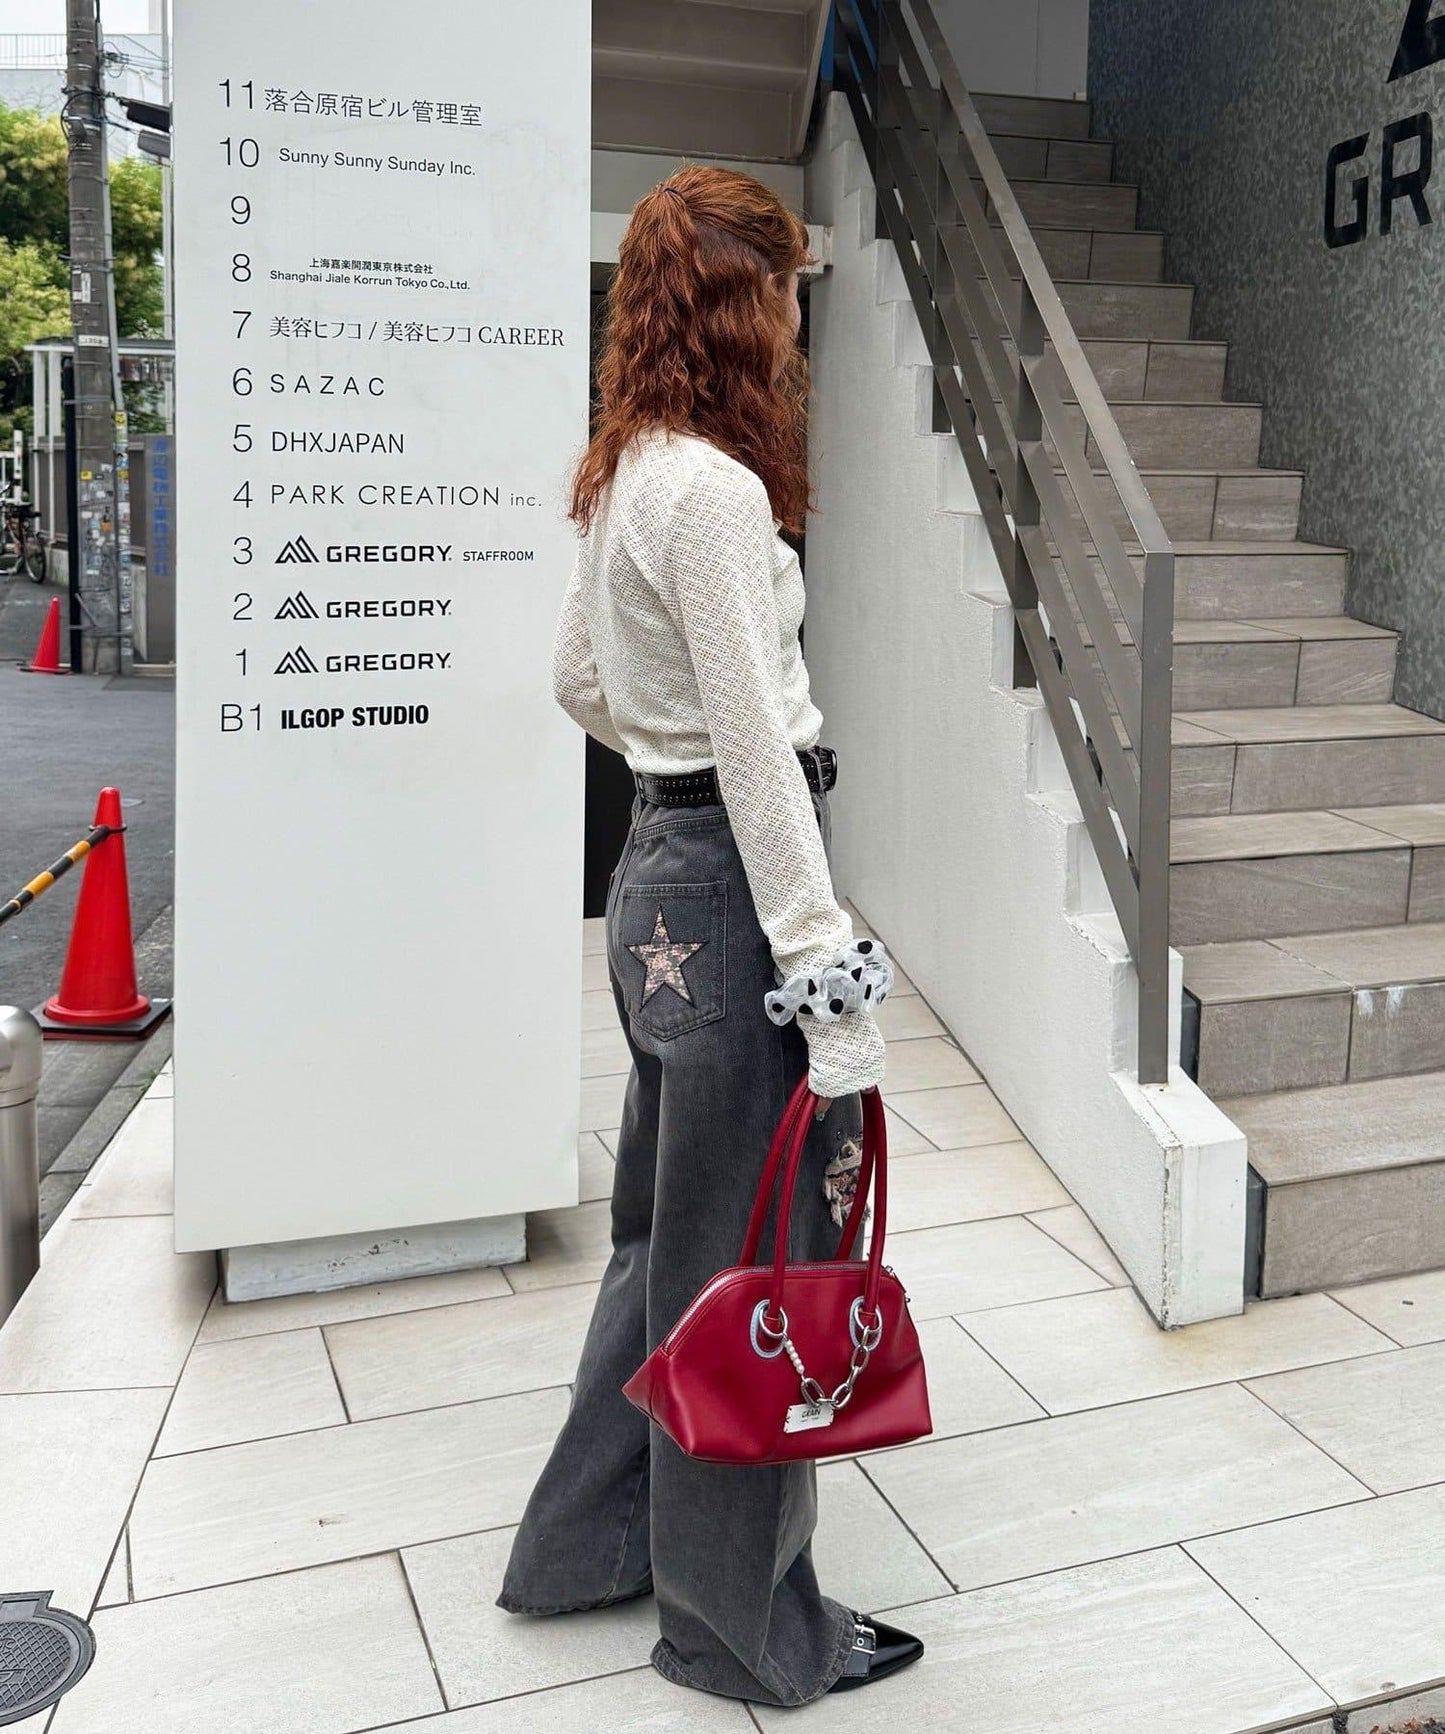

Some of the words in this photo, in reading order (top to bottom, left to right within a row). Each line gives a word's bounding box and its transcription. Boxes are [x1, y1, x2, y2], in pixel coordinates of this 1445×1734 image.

[218, 78, 253, 110] 11
[264, 87, 483, 127] 落合原宿ビル管理室
[219, 136, 260, 168] 10
[278, 147, 330, 169] Sunny
[333, 151, 383, 173] Sunny
[387, 155, 445, 177] Sunday
[450, 160, 476, 176] Inc.
[1324, 111, 1433, 249] GR
[230, 195, 251, 225] 9
[231, 253, 252, 283] 8
[269, 269, 323, 284] Shanghai
[325, 273, 351, 284] Jiale
[353, 274, 393, 286] Korrun
[394, 276, 428, 290] Tokyo
[232, 310, 252, 339] 7
[269, 315, 362, 340] 美容ヒフコ
[383, 320, 471, 344] 美容ヒフコ
[478, 325, 565, 347] CAREER
[232, 367, 253, 397] 6
[270, 373, 385, 397] SAZAC
[232, 423, 253, 453] 5
[271, 431, 404, 454] DHXJAPAN
[232, 480, 254, 509] 4
[271, 484, 345, 505] PARK
[358, 485, 499, 506] CREATION
[510, 492, 542, 507] inc.
[232, 536, 253, 565] 3
[462, 550, 534, 562] STAFFROOM
[232, 592, 253, 621] 2
[235, 647, 247, 677] 1
[220, 703, 261, 733] B1
[280, 707, 345, 730] ILGOP
[351, 704, 430, 727] STUDIO
